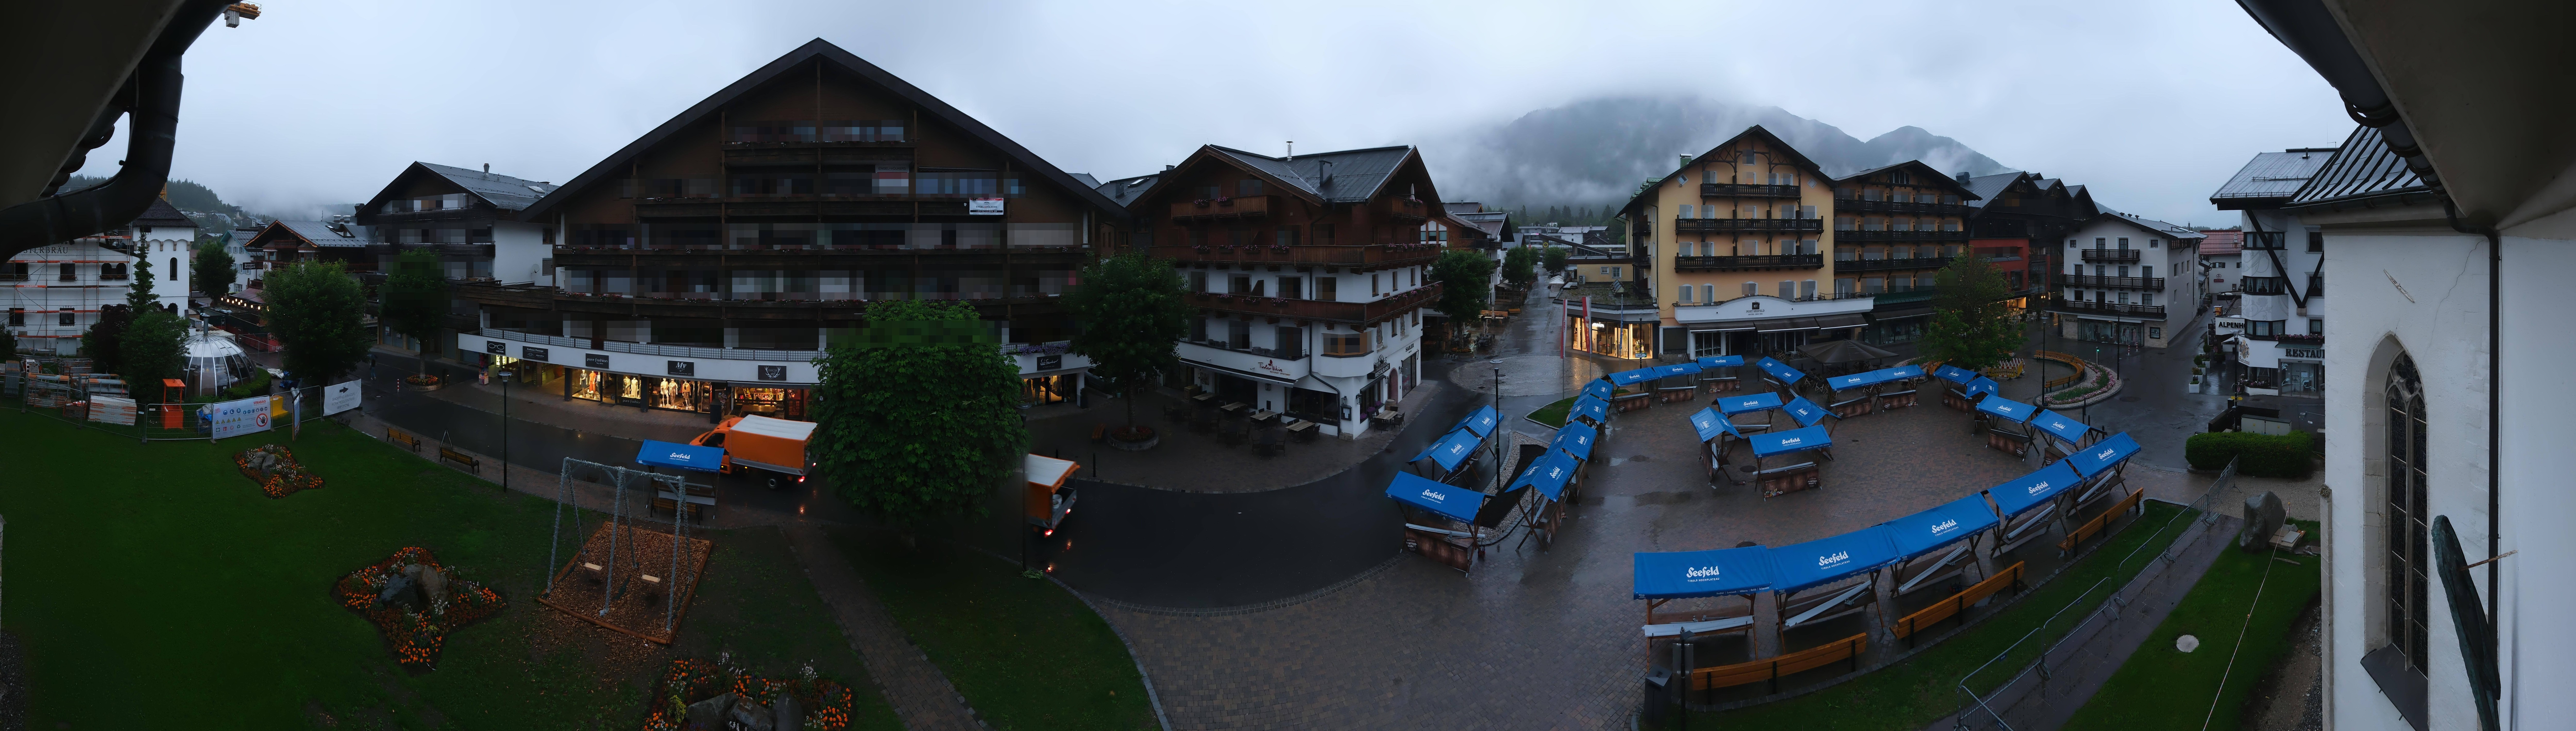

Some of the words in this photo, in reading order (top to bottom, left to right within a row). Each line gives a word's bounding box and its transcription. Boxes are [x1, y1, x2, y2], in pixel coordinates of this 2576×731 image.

[1406, 343, 1414, 352] SAILER
[1375, 365, 1389, 377] RESTAURANT
[1451, 443, 1462, 453] Seefeld
[2098, 448, 2114, 459] Seefeld
[1549, 466, 1560, 479] Seefeld
[2028, 481, 2049, 494] Seefeld
[1422, 489, 1445, 500] Seefeld
[1932, 519, 1956, 533] Seefeld
[1819, 550, 1849, 566] Seefeld
[1686, 565, 1719, 578] Seefeld
